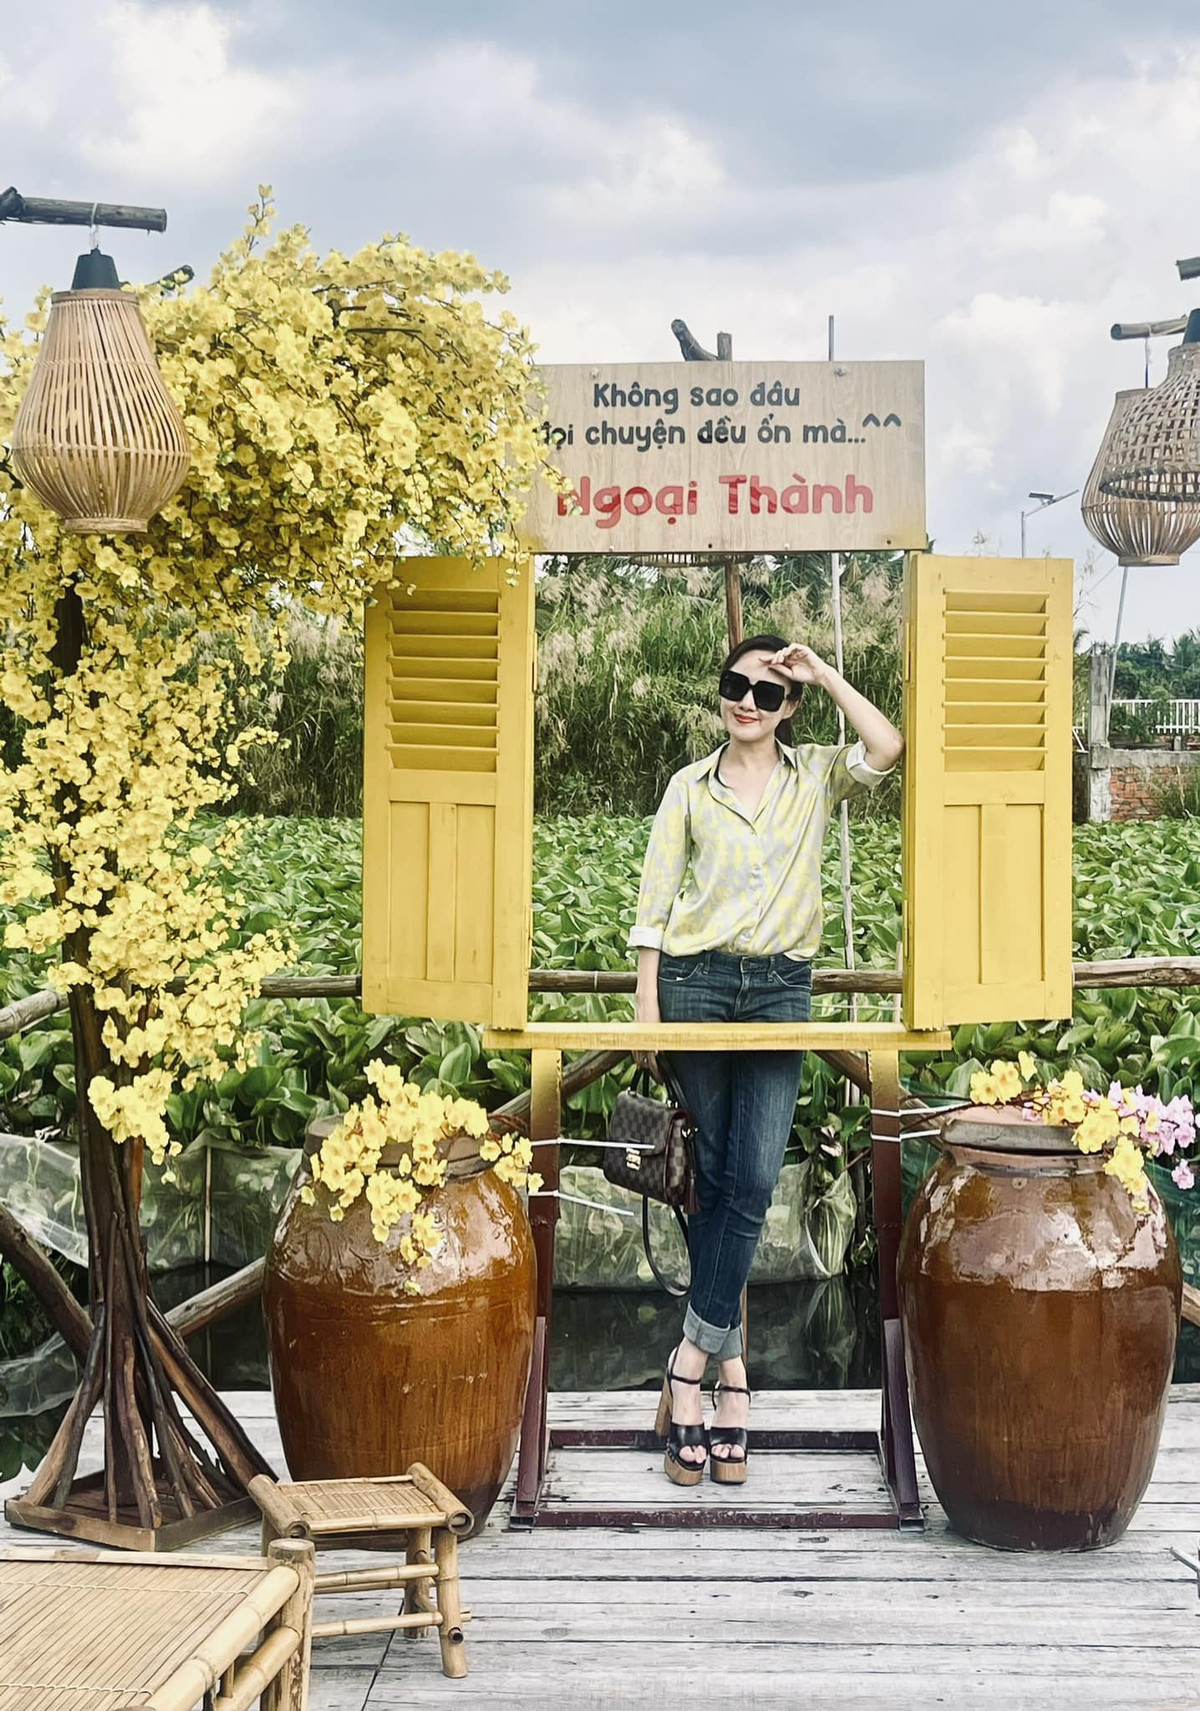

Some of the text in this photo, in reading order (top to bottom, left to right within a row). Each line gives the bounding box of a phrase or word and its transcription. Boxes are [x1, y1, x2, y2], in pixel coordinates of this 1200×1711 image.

[593, 380, 800, 414] Không sao đâu
[585, 418, 686, 453] chuyện
[697, 415, 746, 444] đều
[757, 413, 791, 443] ổn
[557, 473, 874, 529] Ngoại Thành
